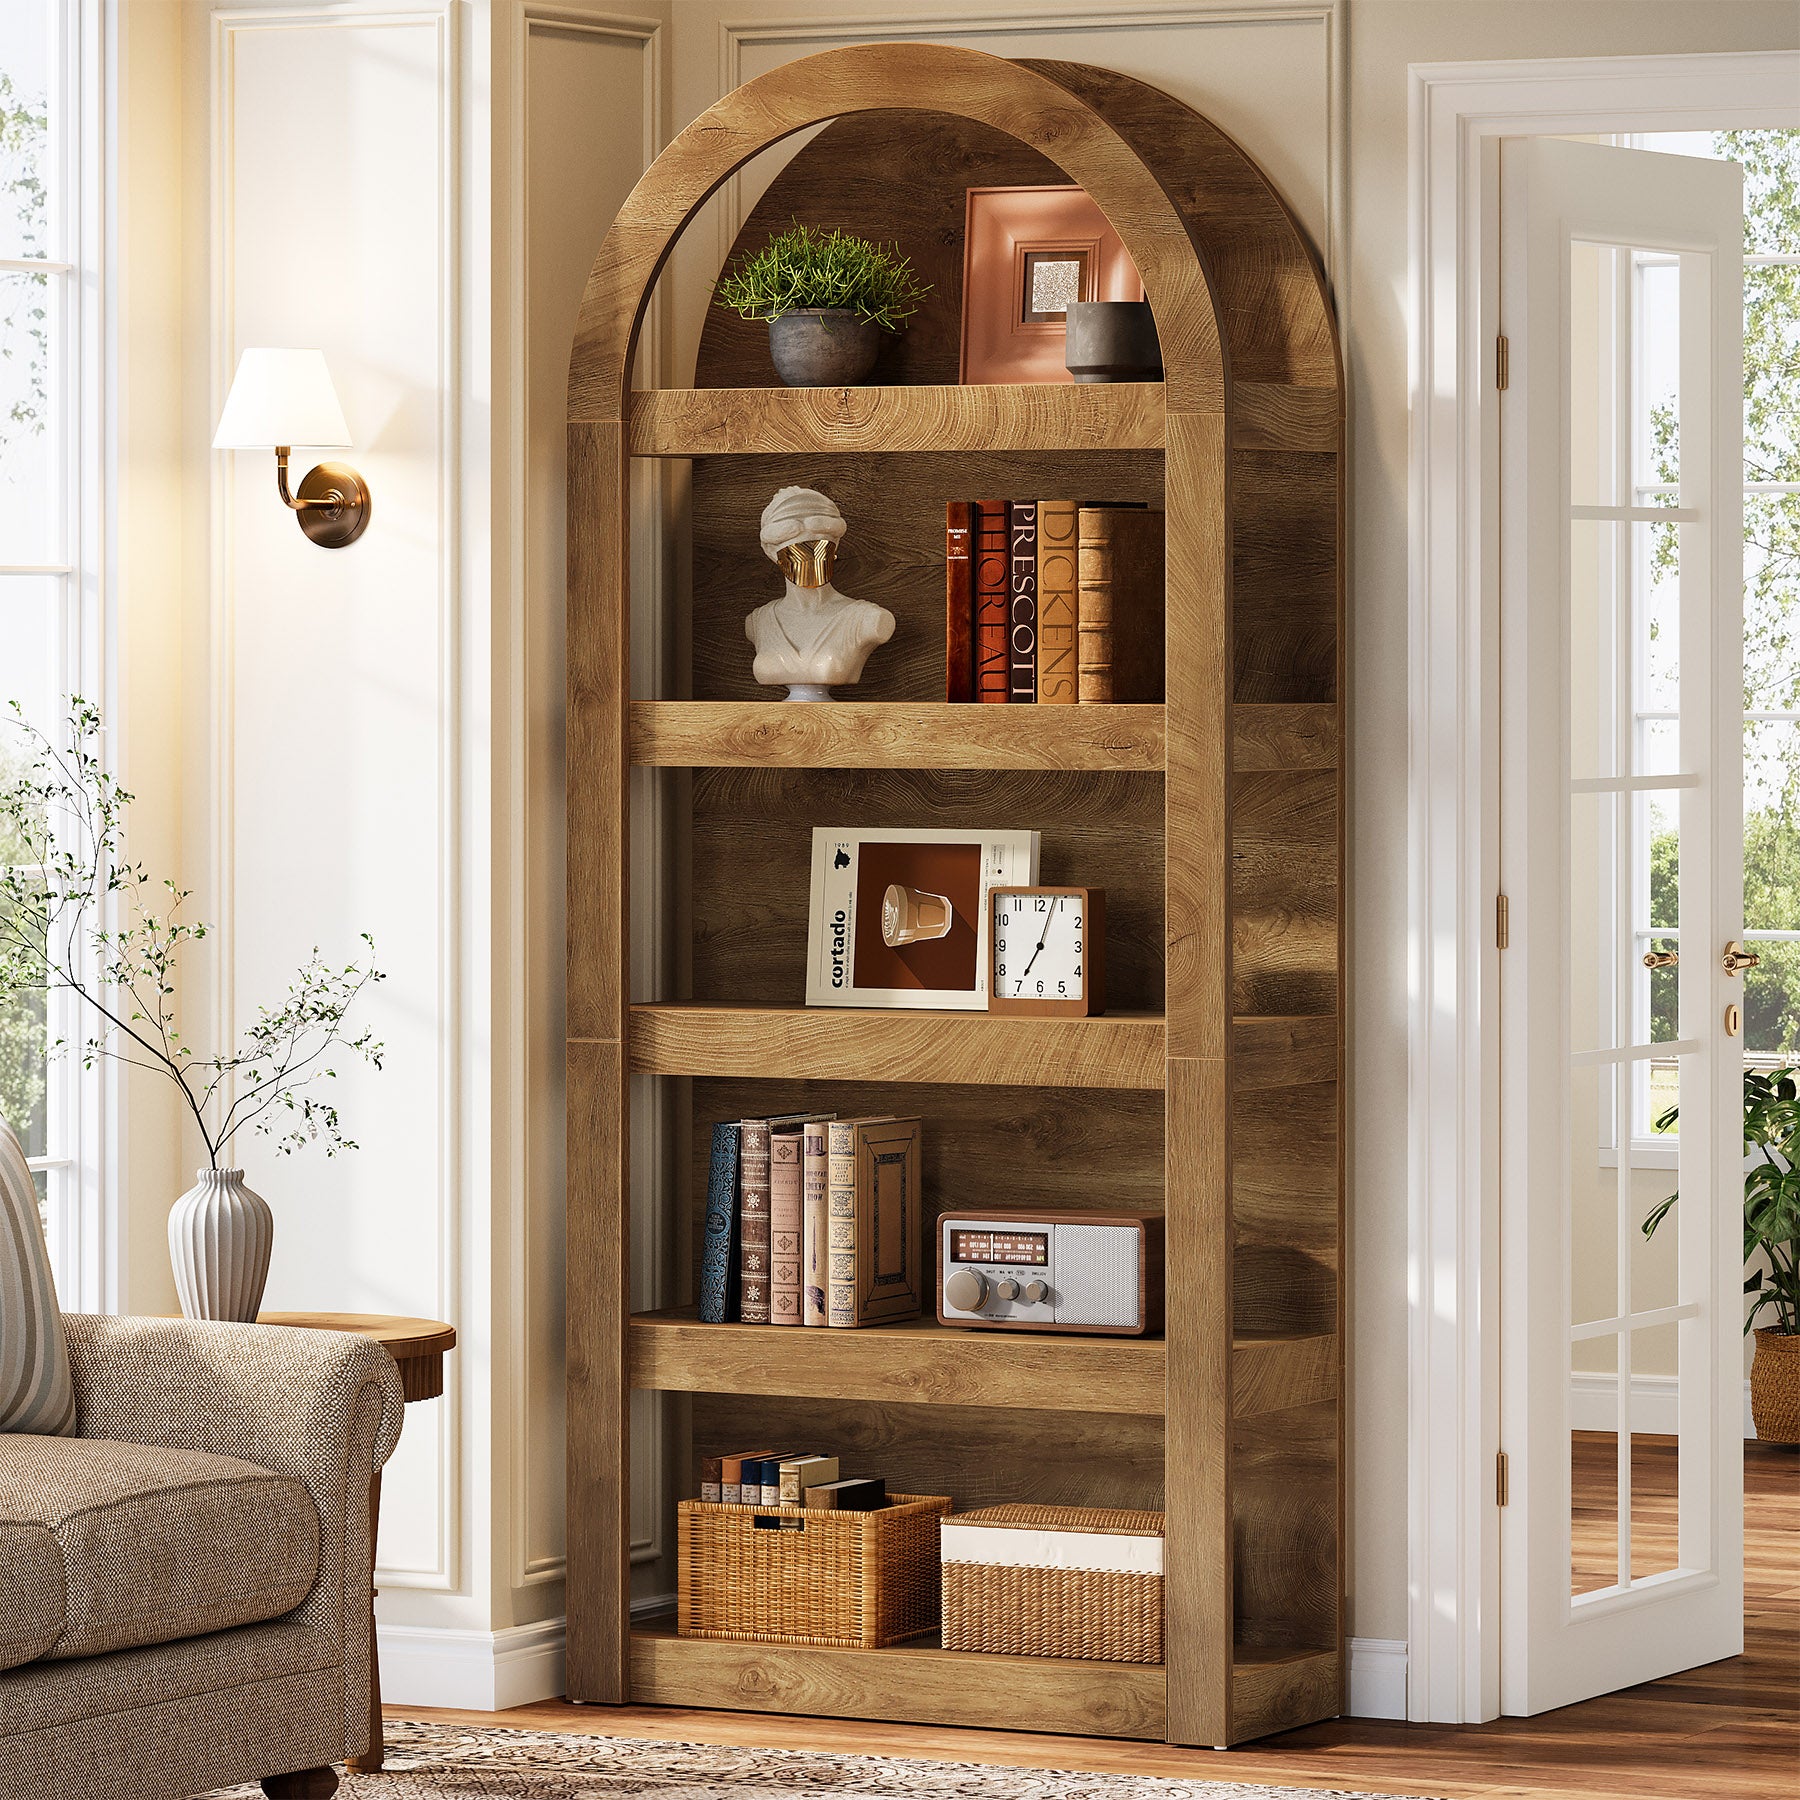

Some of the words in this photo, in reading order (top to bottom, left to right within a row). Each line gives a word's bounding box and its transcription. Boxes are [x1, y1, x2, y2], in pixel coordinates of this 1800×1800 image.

[978, 503, 1007, 693] THOREAU
[1012, 503, 1035, 703] PRESCOTT
[1042, 511, 1074, 698] DICKENS
[1014, 899, 1022, 912] 11
[1034, 898, 1046, 912] 12
[1060, 899, 1064, 912] 1
[998, 914, 1009, 927] 10
[1074, 917, 1082, 929] 2
[831, 910, 846, 988] cortado
[999, 939, 1007, 952] 9
[1074, 940, 1082, 954] 3
[999, 964, 1007, 977] 8
[1074, 965, 1082, 978] 4
[1015, 980, 1022, 993] 7
[1036, 980, 1044, 993] 6
[1057, 980, 1065, 994] 5
